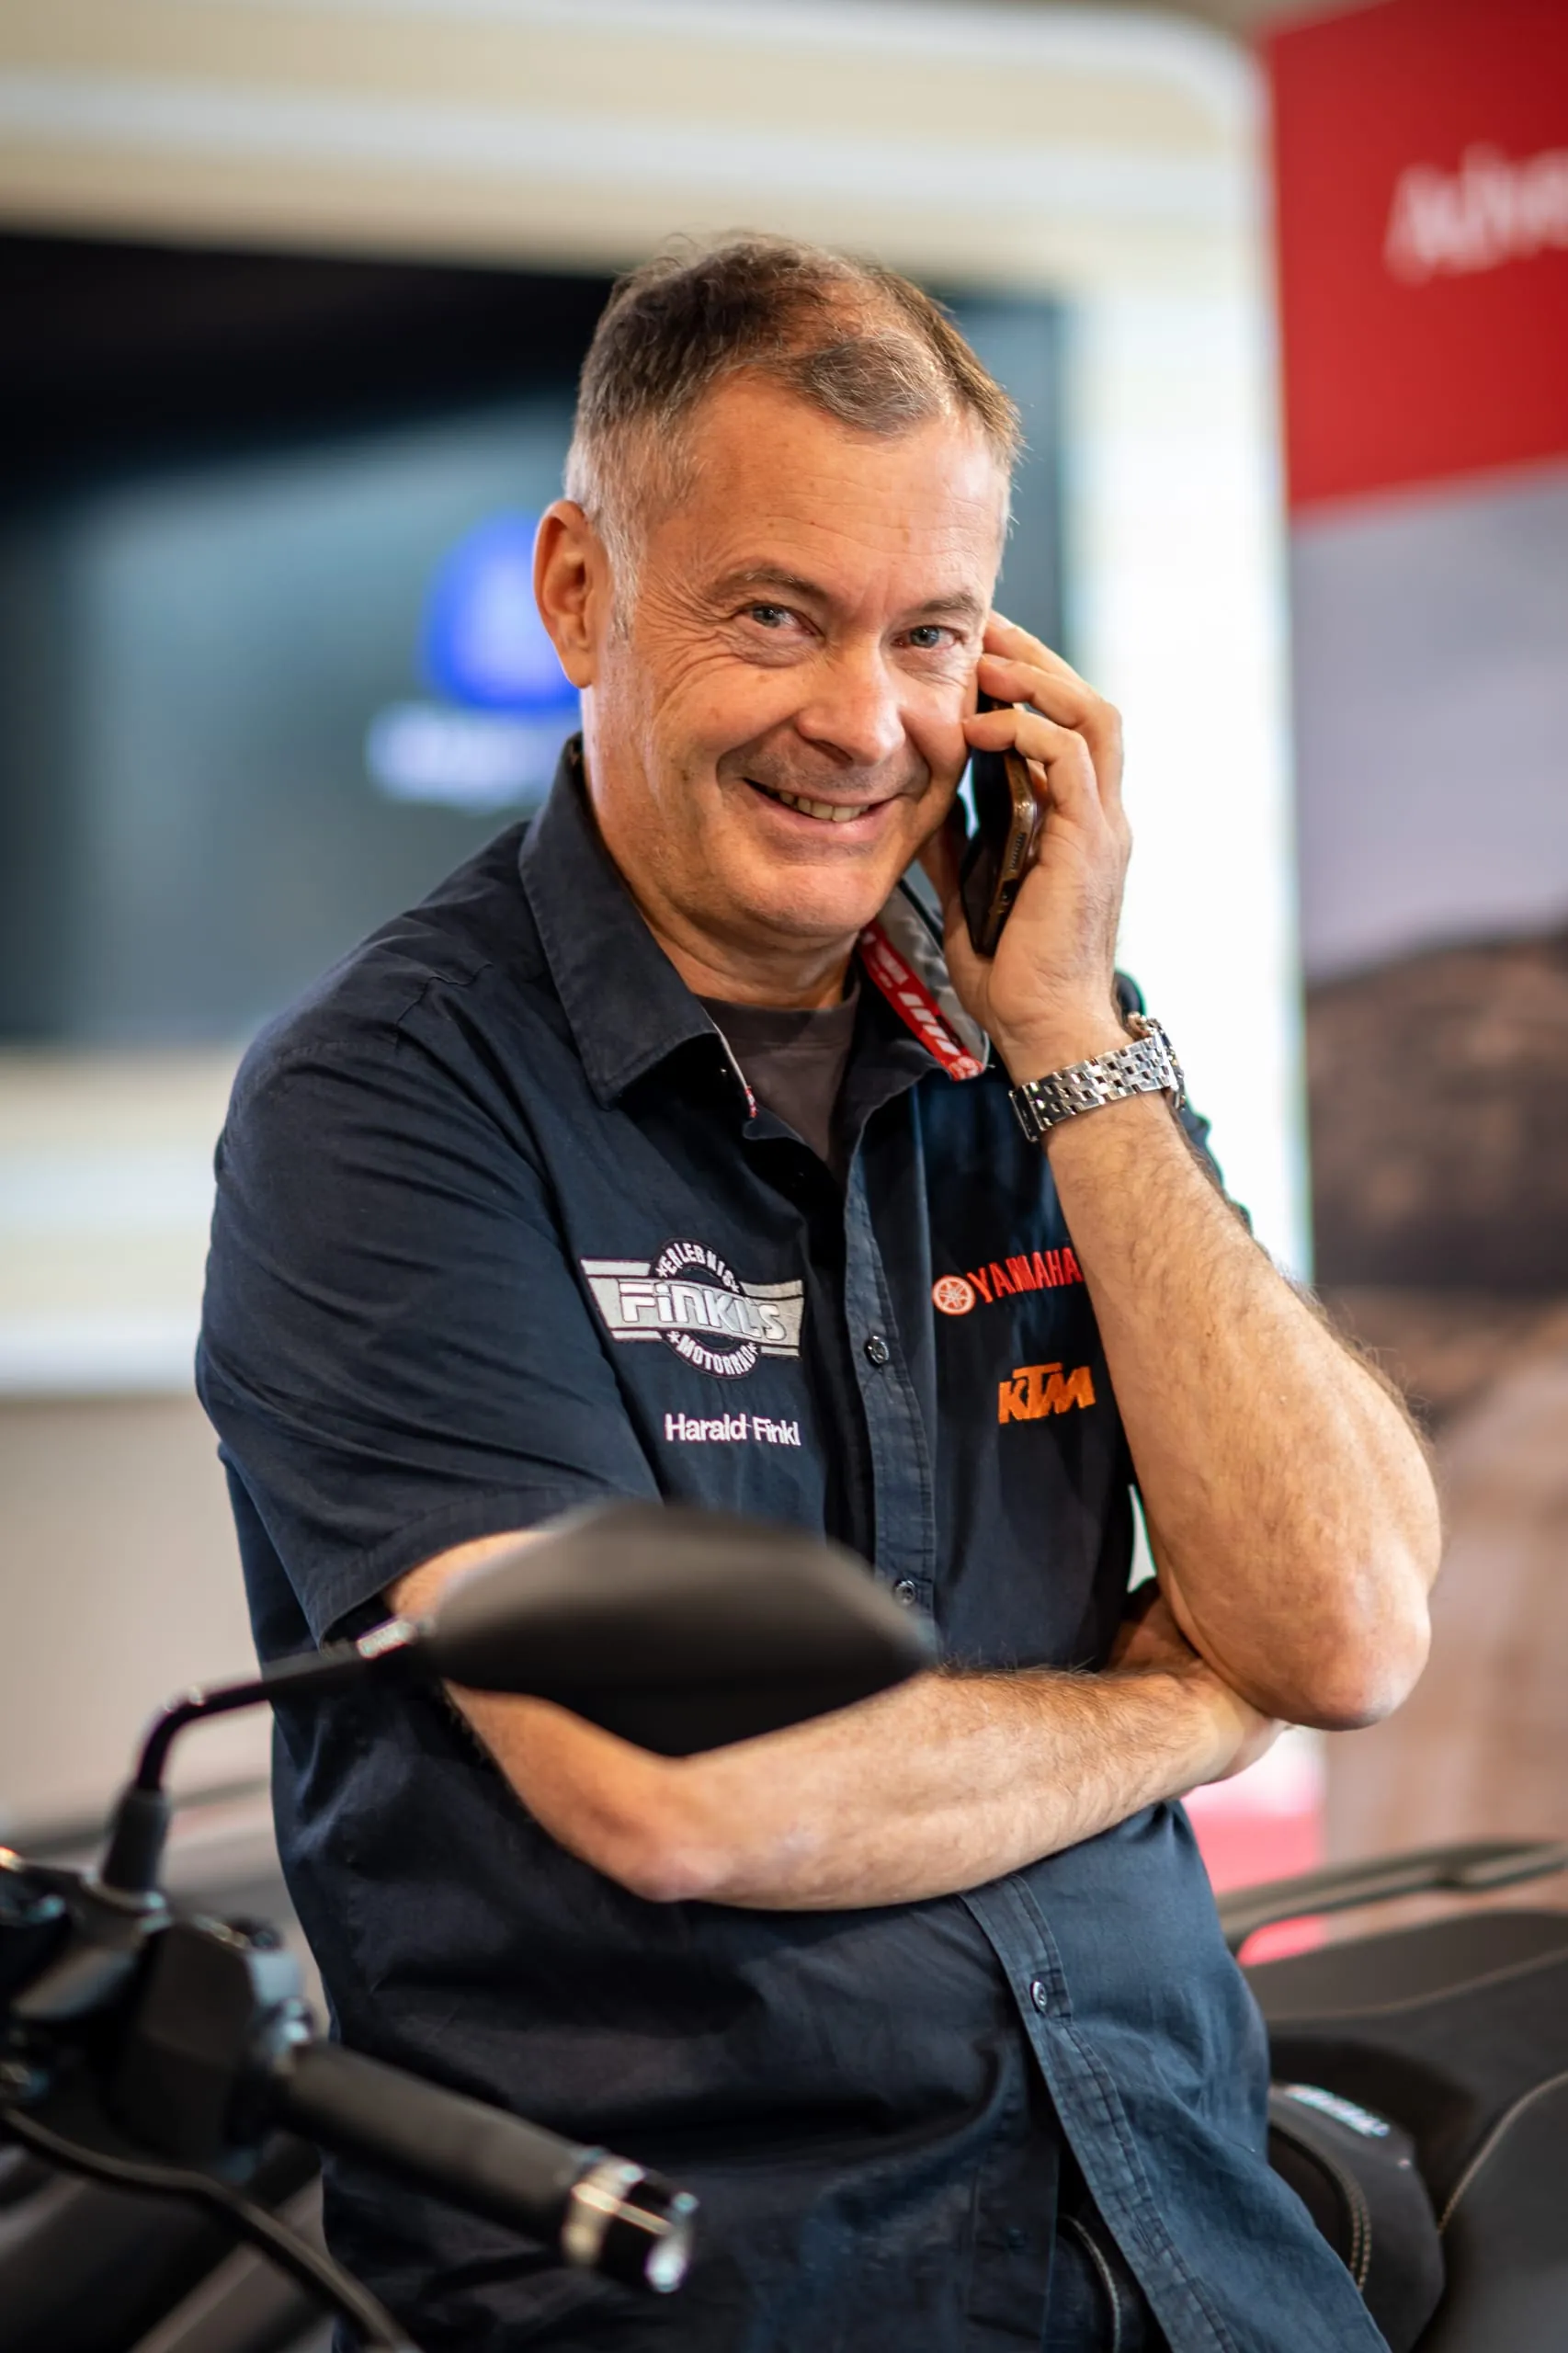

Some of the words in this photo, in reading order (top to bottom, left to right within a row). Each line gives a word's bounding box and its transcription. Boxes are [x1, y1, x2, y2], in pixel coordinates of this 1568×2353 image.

[967, 1246, 1084, 1303] YAMAHA
[676, 1334, 756, 1375] MOTORRAD
[998, 1362, 1096, 1424] KTM
[665, 1413, 746, 1441] Harald
[752, 1415, 801, 1446] Finkl
